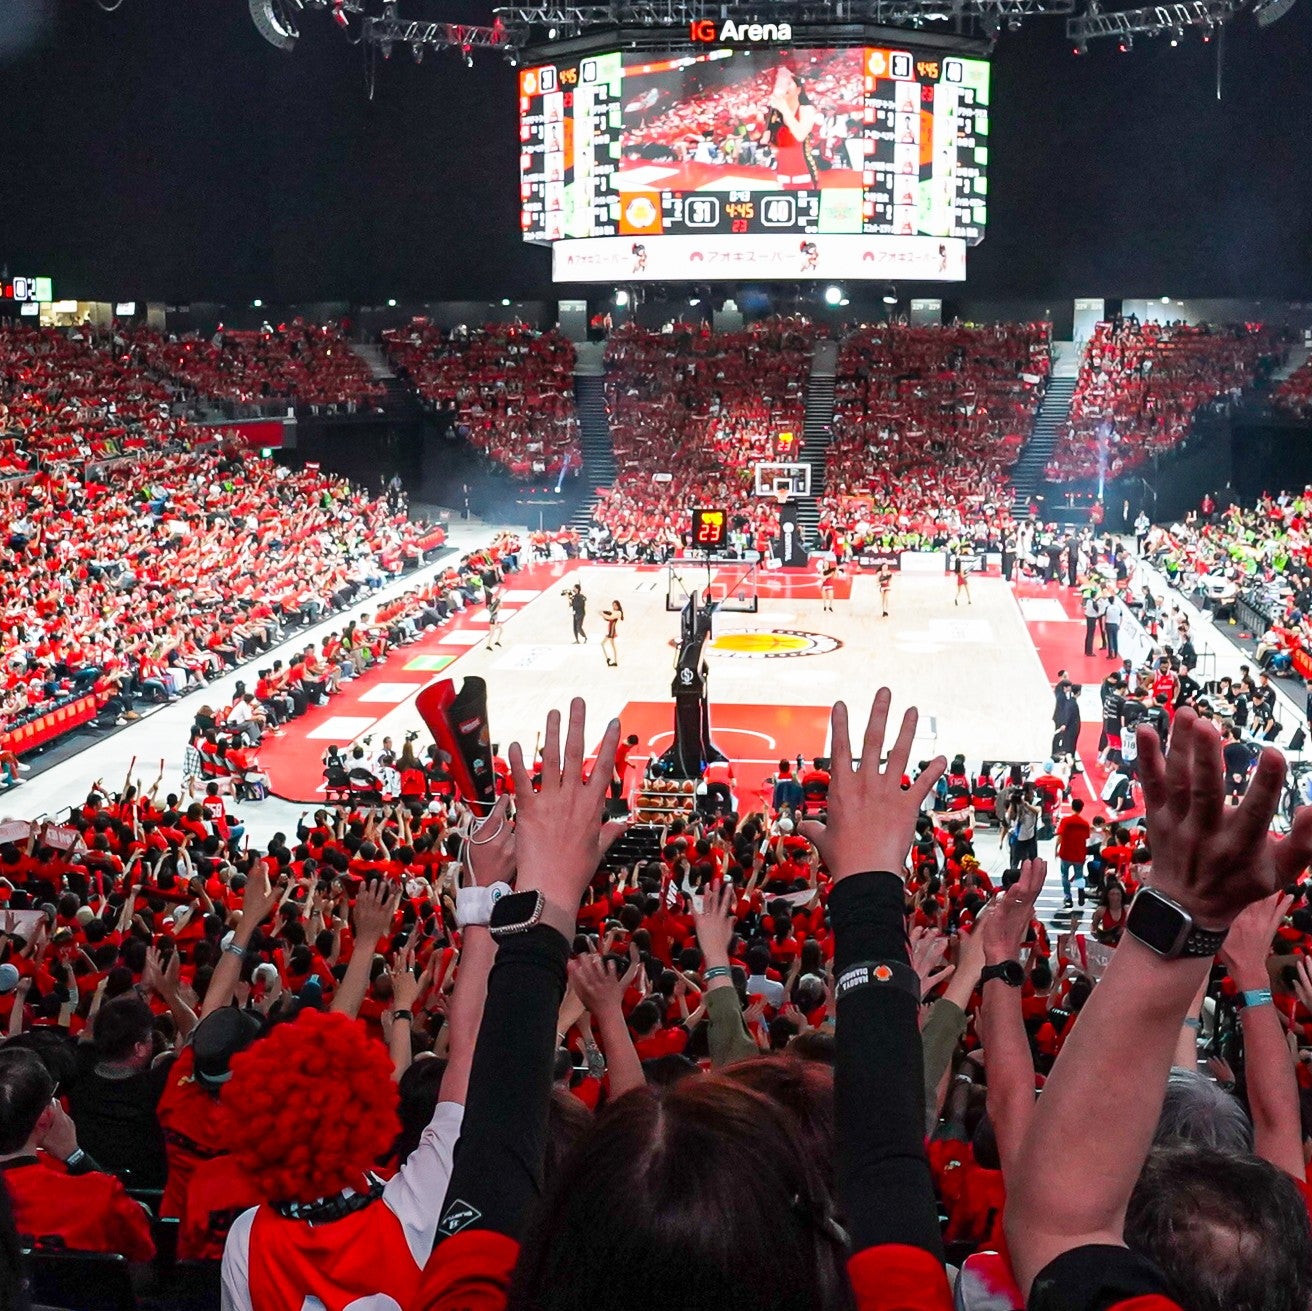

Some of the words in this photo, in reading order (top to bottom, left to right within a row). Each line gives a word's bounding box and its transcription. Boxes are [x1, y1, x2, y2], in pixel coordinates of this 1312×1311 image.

[689, 20, 717, 43] IG
[719, 19, 792, 42] Arena
[692, 201, 712, 223] 31
[725, 202, 755, 219] 4:45
[767, 201, 789, 222] 40
[707, 250, 797, 262] アオキスーパー
[699, 524, 721, 541] 23
[842, 974, 869, 991] NAGOYA
